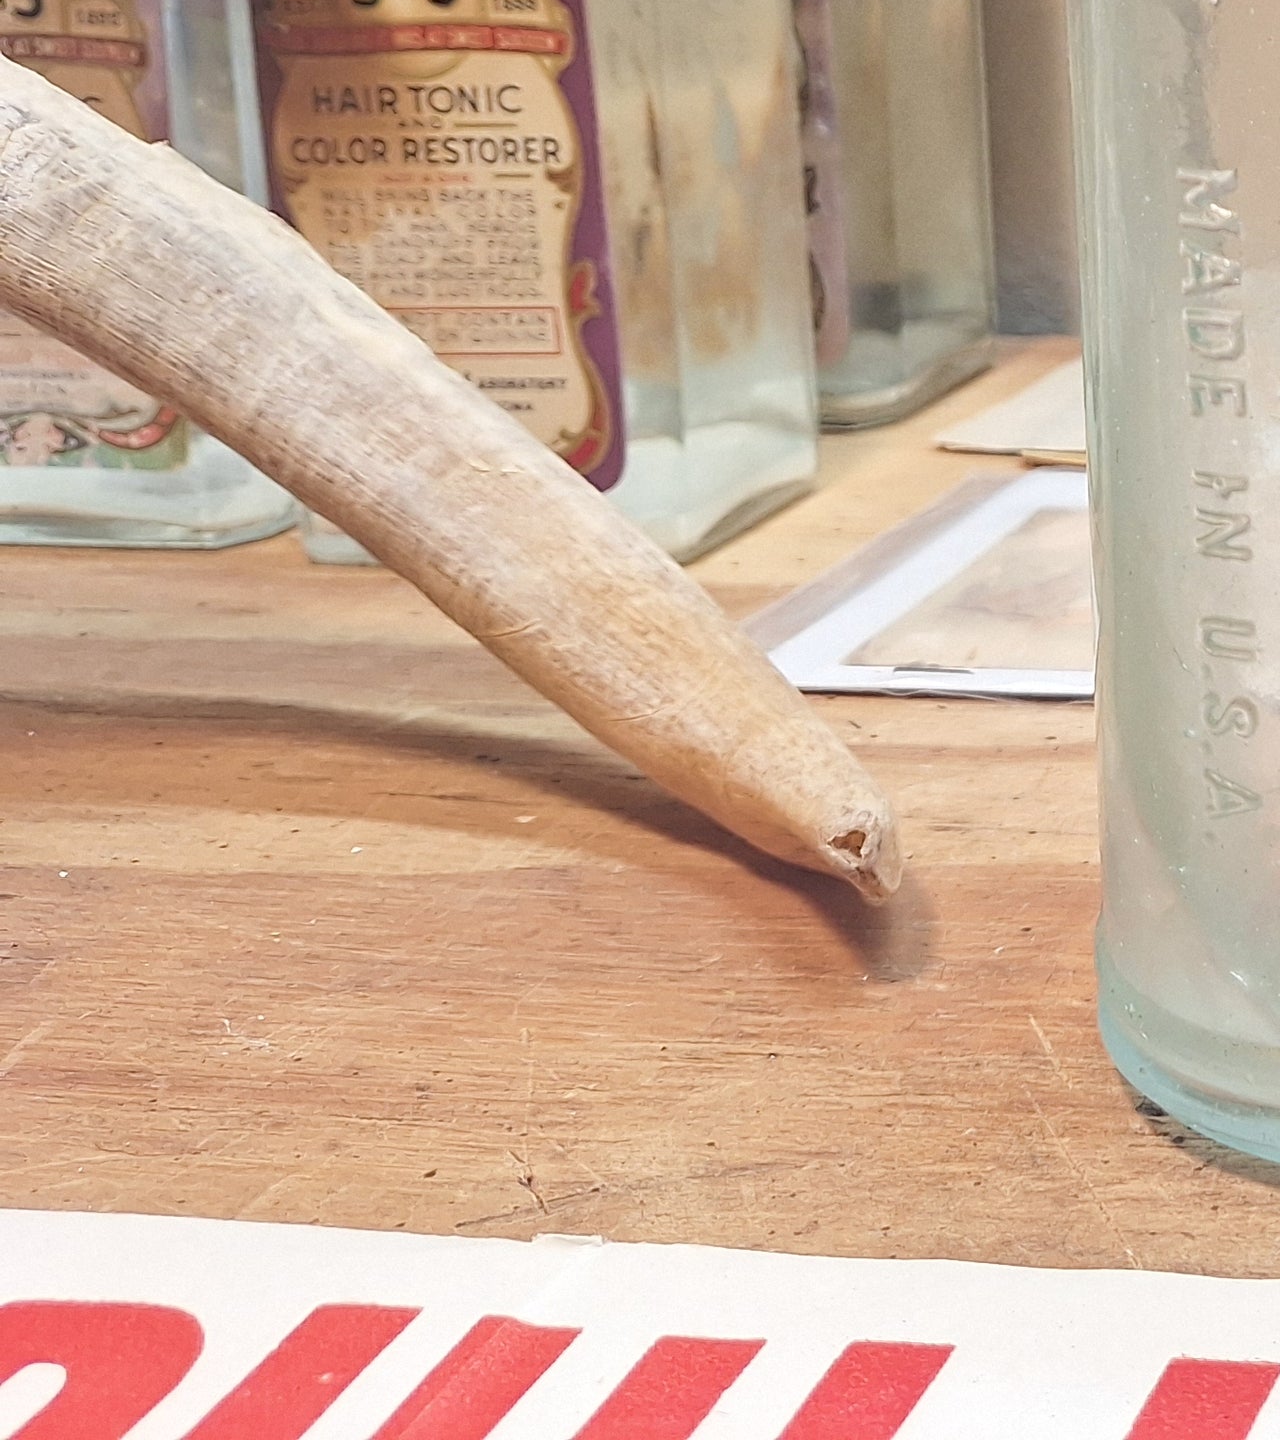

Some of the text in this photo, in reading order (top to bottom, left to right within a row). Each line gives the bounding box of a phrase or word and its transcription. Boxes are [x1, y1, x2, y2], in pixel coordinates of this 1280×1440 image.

[311, 83, 523, 114] HAIR TONIC
[291, 136, 562, 165] COLOR RESTORER
[1175, 165, 1252, 419] MADE
[1189, 466, 1253, 561] IN
